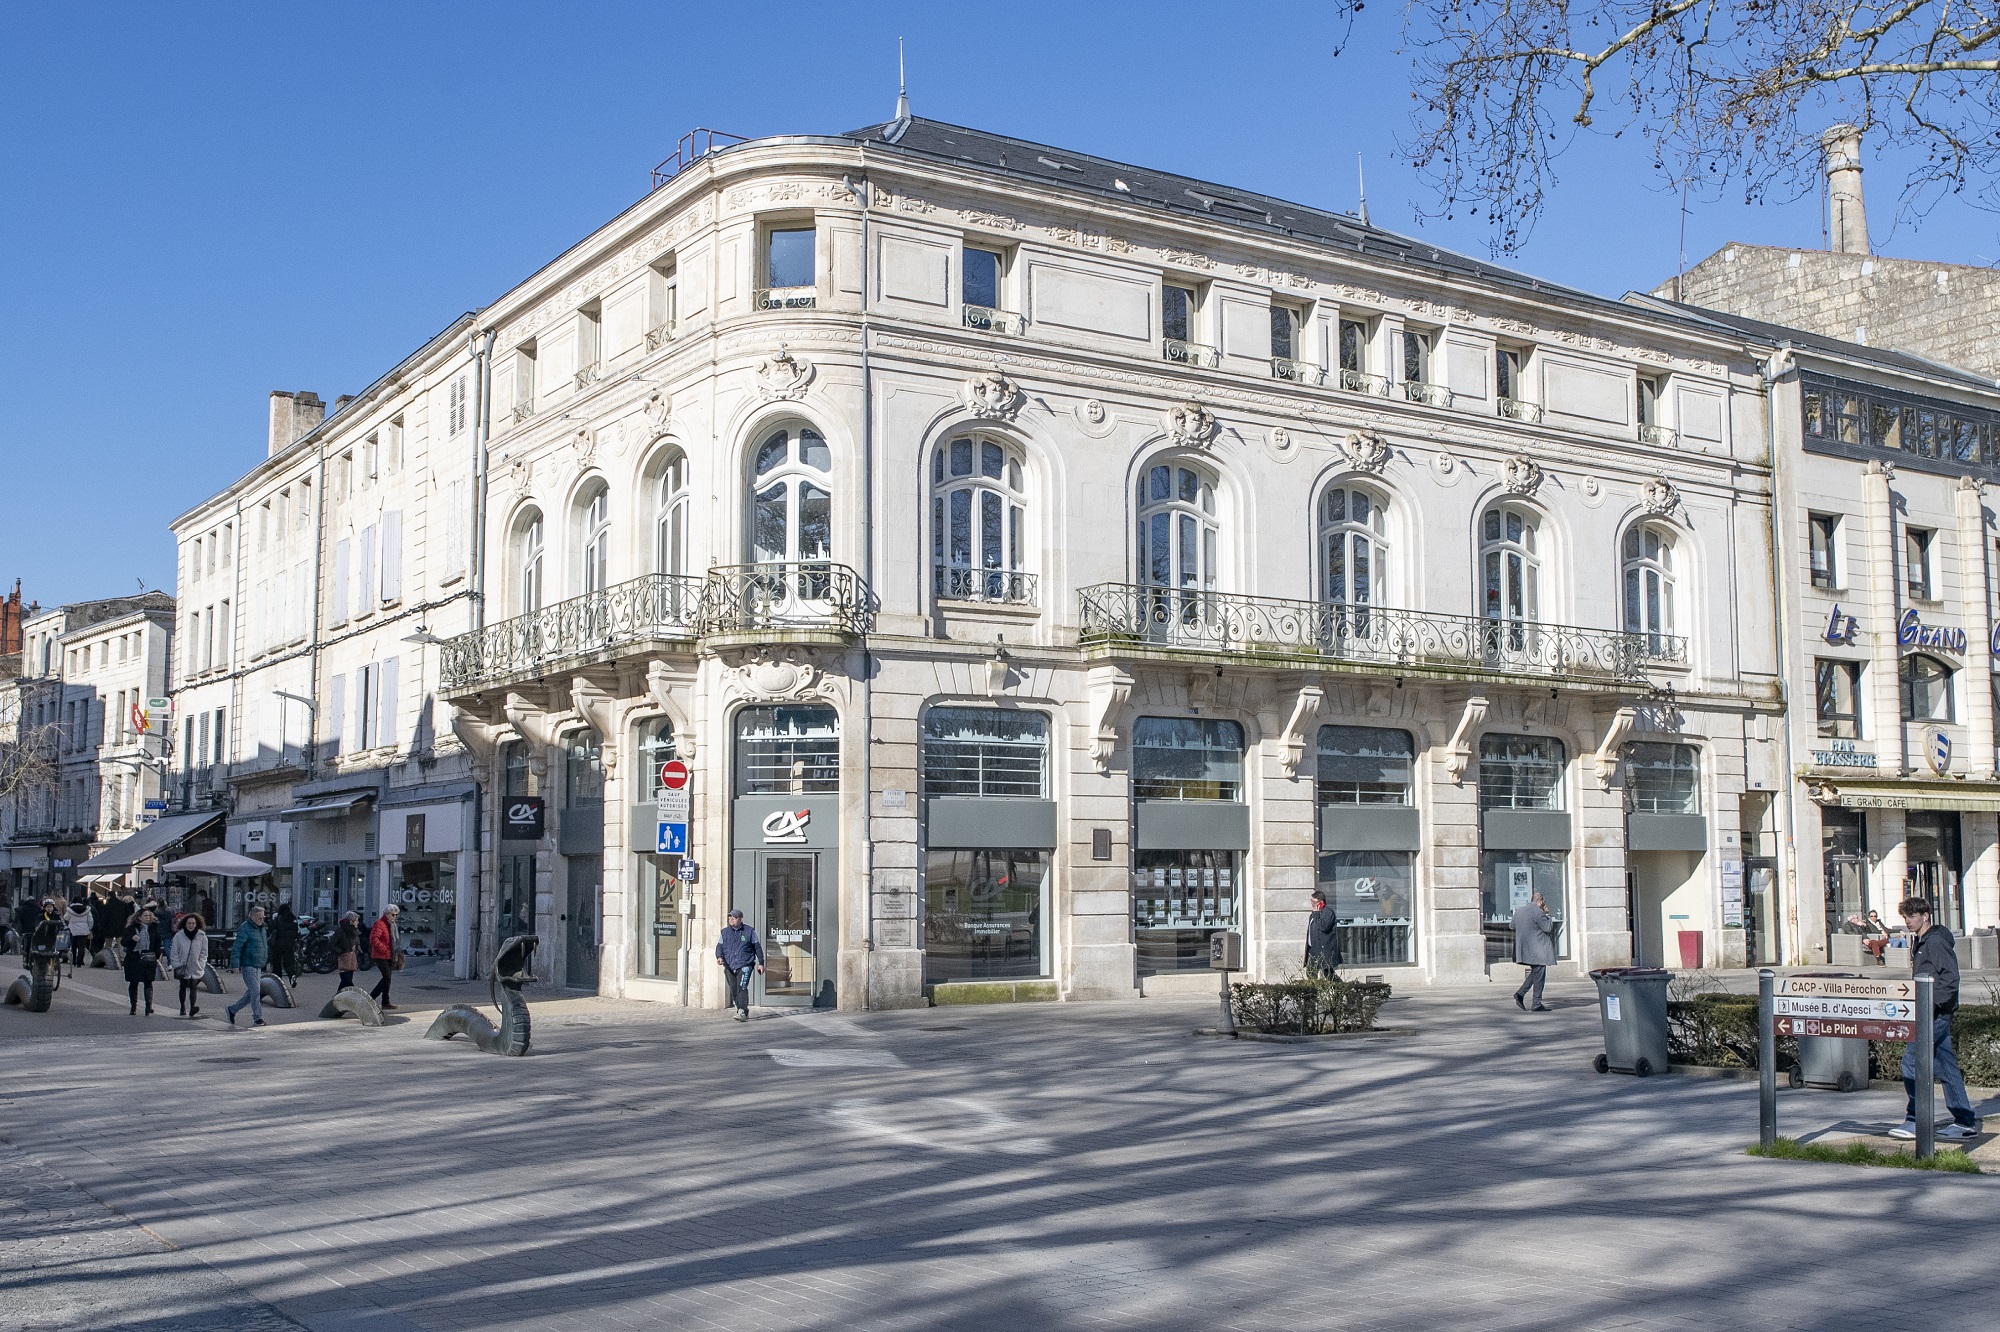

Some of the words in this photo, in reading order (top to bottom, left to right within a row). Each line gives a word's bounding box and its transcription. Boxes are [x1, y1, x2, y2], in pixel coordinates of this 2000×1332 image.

[1900, 608, 1966, 650] GRAND
[1830, 740, 1855, 752] BAR
[1814, 751, 1877, 768] BRASSERIE
[1857, 798, 1882, 807] GRAND
[771, 928, 811, 936] bienvenue
[1792, 982, 1817, 992] CACP
[1823, 983, 1842, 993] Villa
[1844, 984, 1887, 995] Pérochon
[1792, 1002, 1819, 1012] Musée
[1822, 1003, 1831, 1013] B.
[1833, 1004, 1871, 1016] d'Agesci
[1821, 1023, 1832, 1034] Le
[1834, 1024, 1857, 1035] Pilori
